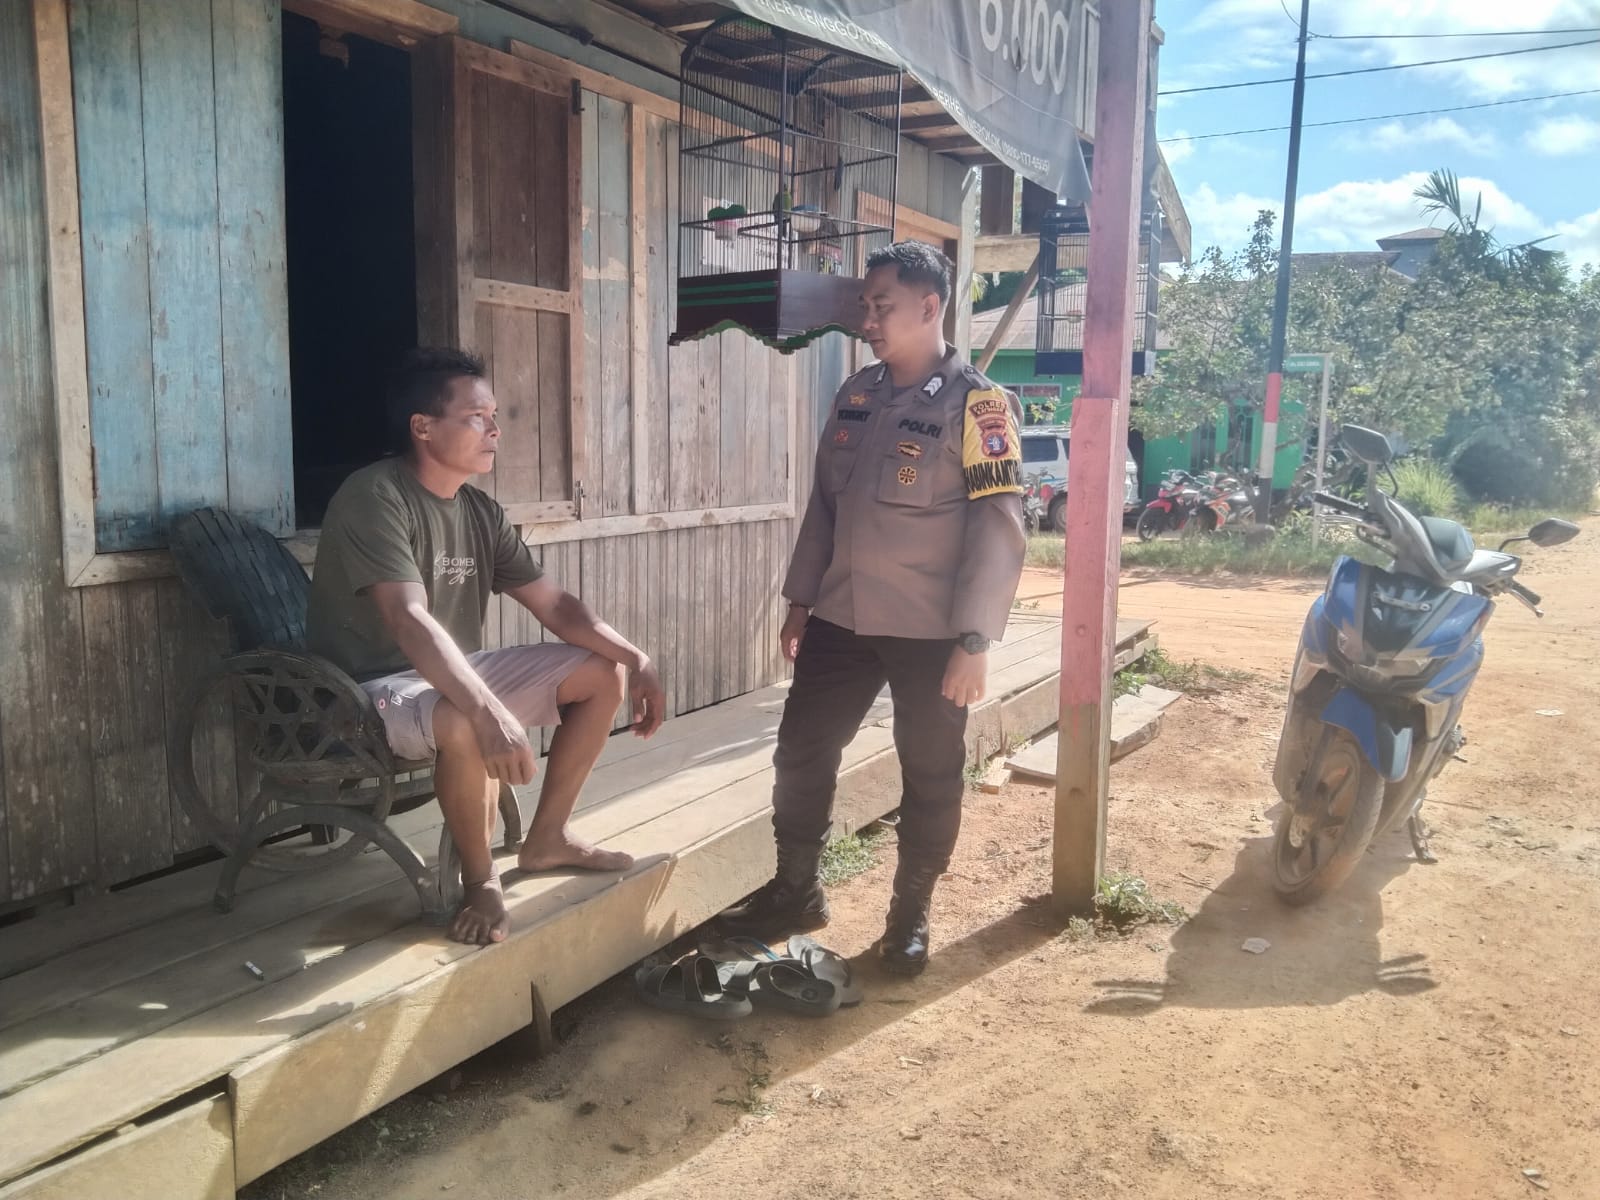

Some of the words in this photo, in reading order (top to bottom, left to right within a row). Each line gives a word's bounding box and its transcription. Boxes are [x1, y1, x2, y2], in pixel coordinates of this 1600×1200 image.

[972, 400, 1005, 412] POLRES
[898, 419, 942, 439] POLRI
[442, 557, 474, 567] BOMB
